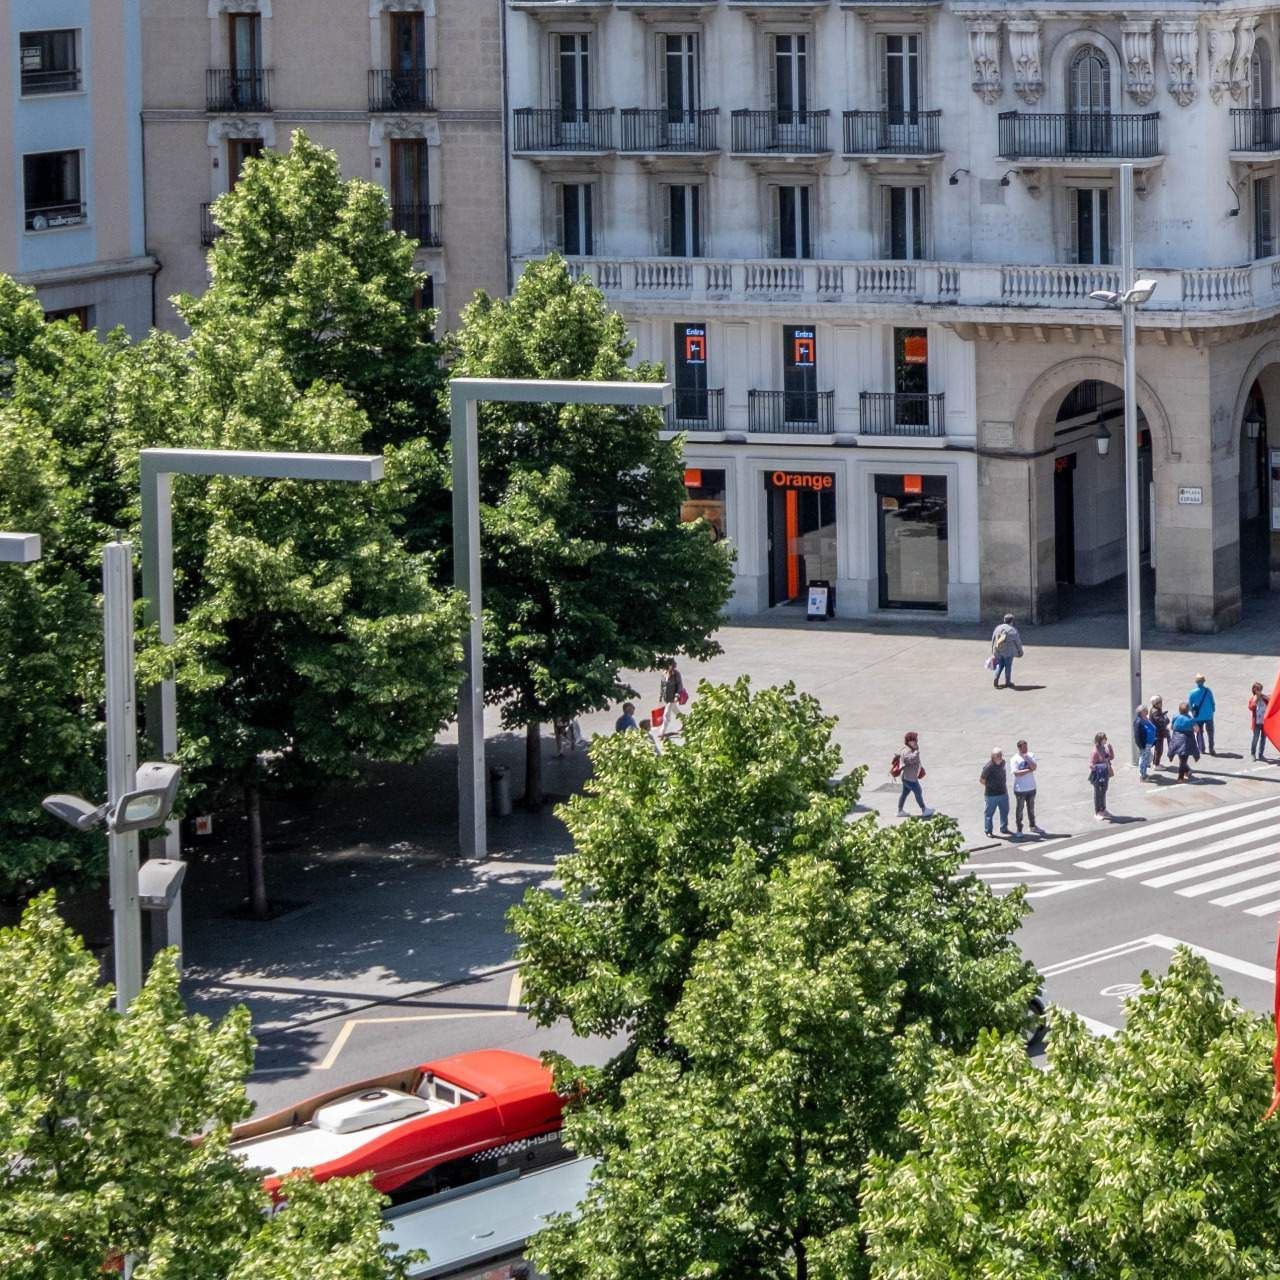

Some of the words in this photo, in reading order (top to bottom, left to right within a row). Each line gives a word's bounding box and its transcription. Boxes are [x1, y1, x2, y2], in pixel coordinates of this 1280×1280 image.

[686, 328, 705, 336] Entra
[795, 330, 814, 338] Entra
[772, 471, 833, 491] Orange
[527, 1131, 563, 1147] HYB
